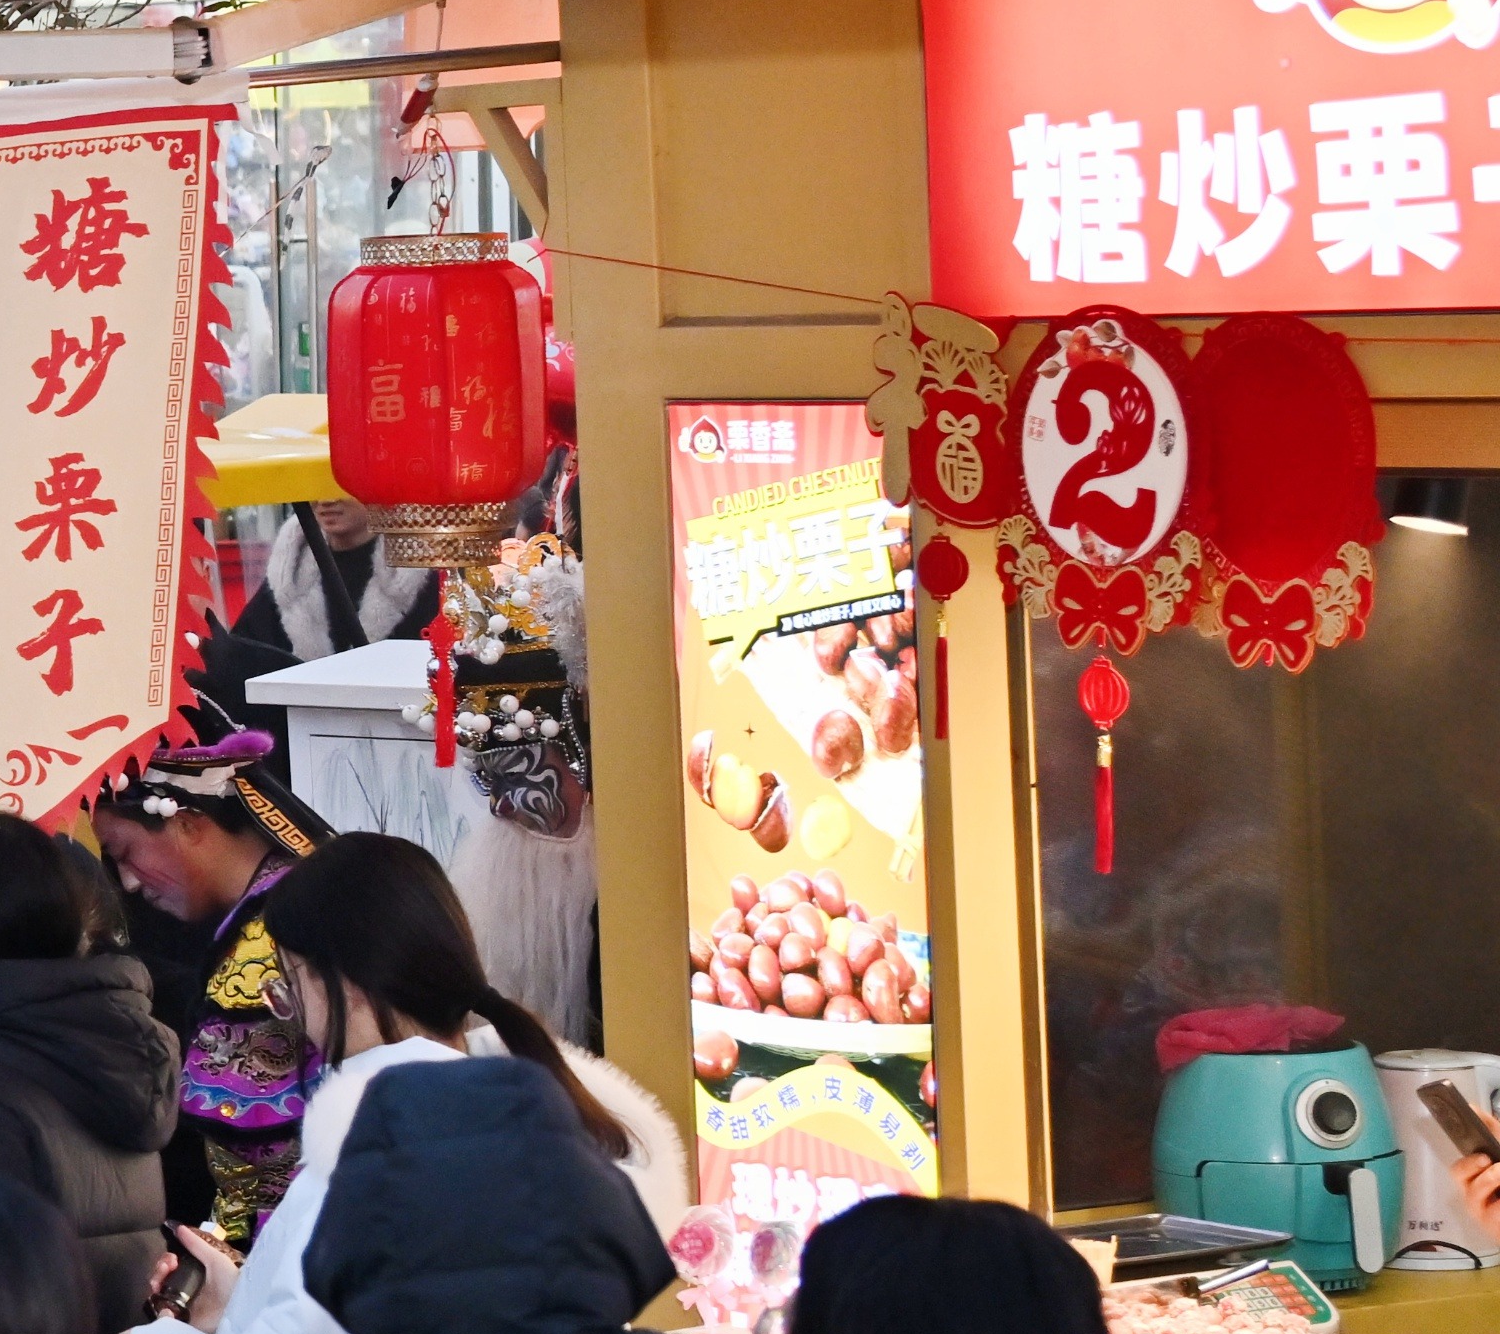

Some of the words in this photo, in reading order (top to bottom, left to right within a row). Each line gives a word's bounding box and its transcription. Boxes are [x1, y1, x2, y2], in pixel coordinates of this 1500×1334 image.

[1008, 91, 1500, 284] 糖炒栗
[18, 176, 151, 697] 糖炒栗子
[711, 479, 788, 520] CANDIED
[1049, 361, 1156, 549] 2
[683, 499, 910, 621] 糖炒栗子
[731, 1162, 898, 1224] 现炒现
